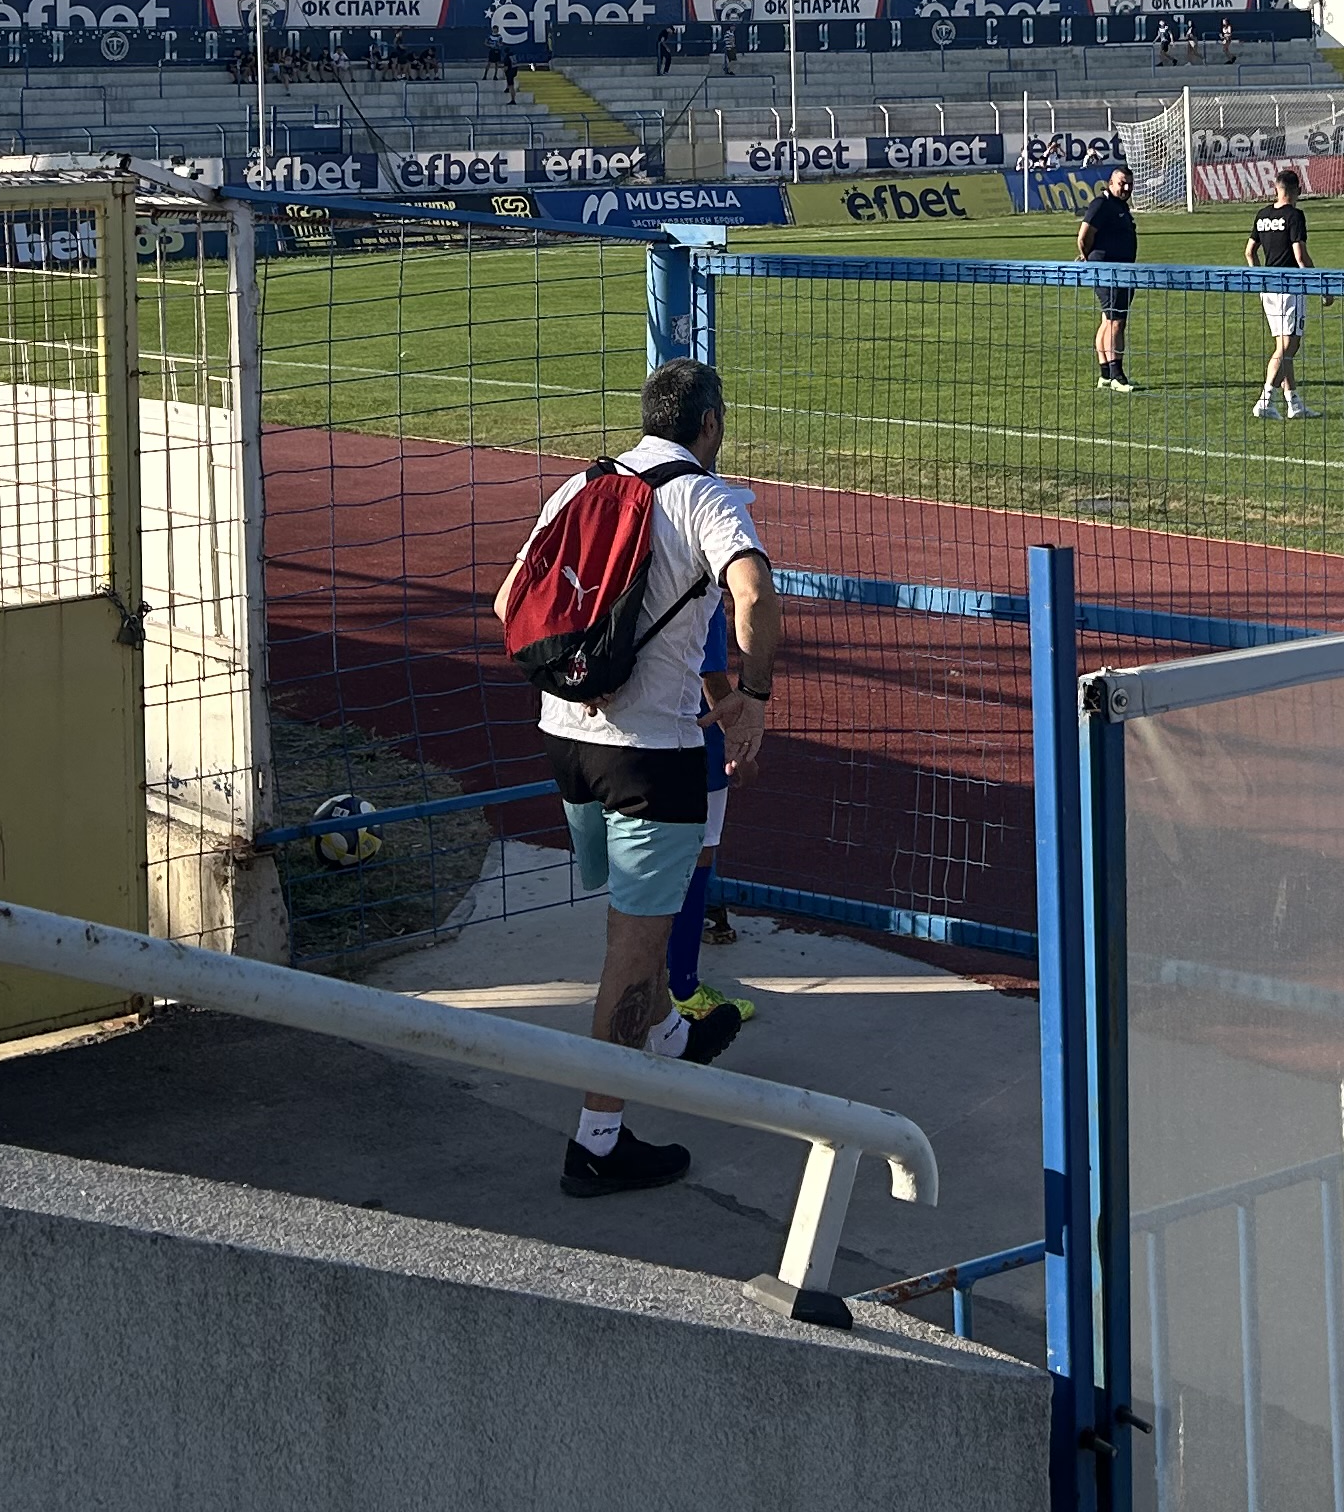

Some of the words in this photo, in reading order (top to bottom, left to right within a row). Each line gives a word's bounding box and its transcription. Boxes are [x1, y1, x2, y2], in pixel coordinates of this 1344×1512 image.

[302, 0, 330, 17] ФК
[335, 0, 421, 17] СПАРТАК
[764, 0, 788, 15] ФК
[748, 140, 850, 172] efbet
[886, 135, 988, 169] efbet
[1027, 133, 1127, 162] efbet
[1192, 128, 1269, 161] fbet
[246, 156, 361, 191] efbet
[400, 152, 508, 187] efbet
[545, 146, 647, 182] efbet
[1196, 158, 1312, 201] WINBT
[625, 190, 741, 210] MUSSALA
[845, 181, 966, 220] efbet
[13, 218, 185, 263] bet65
